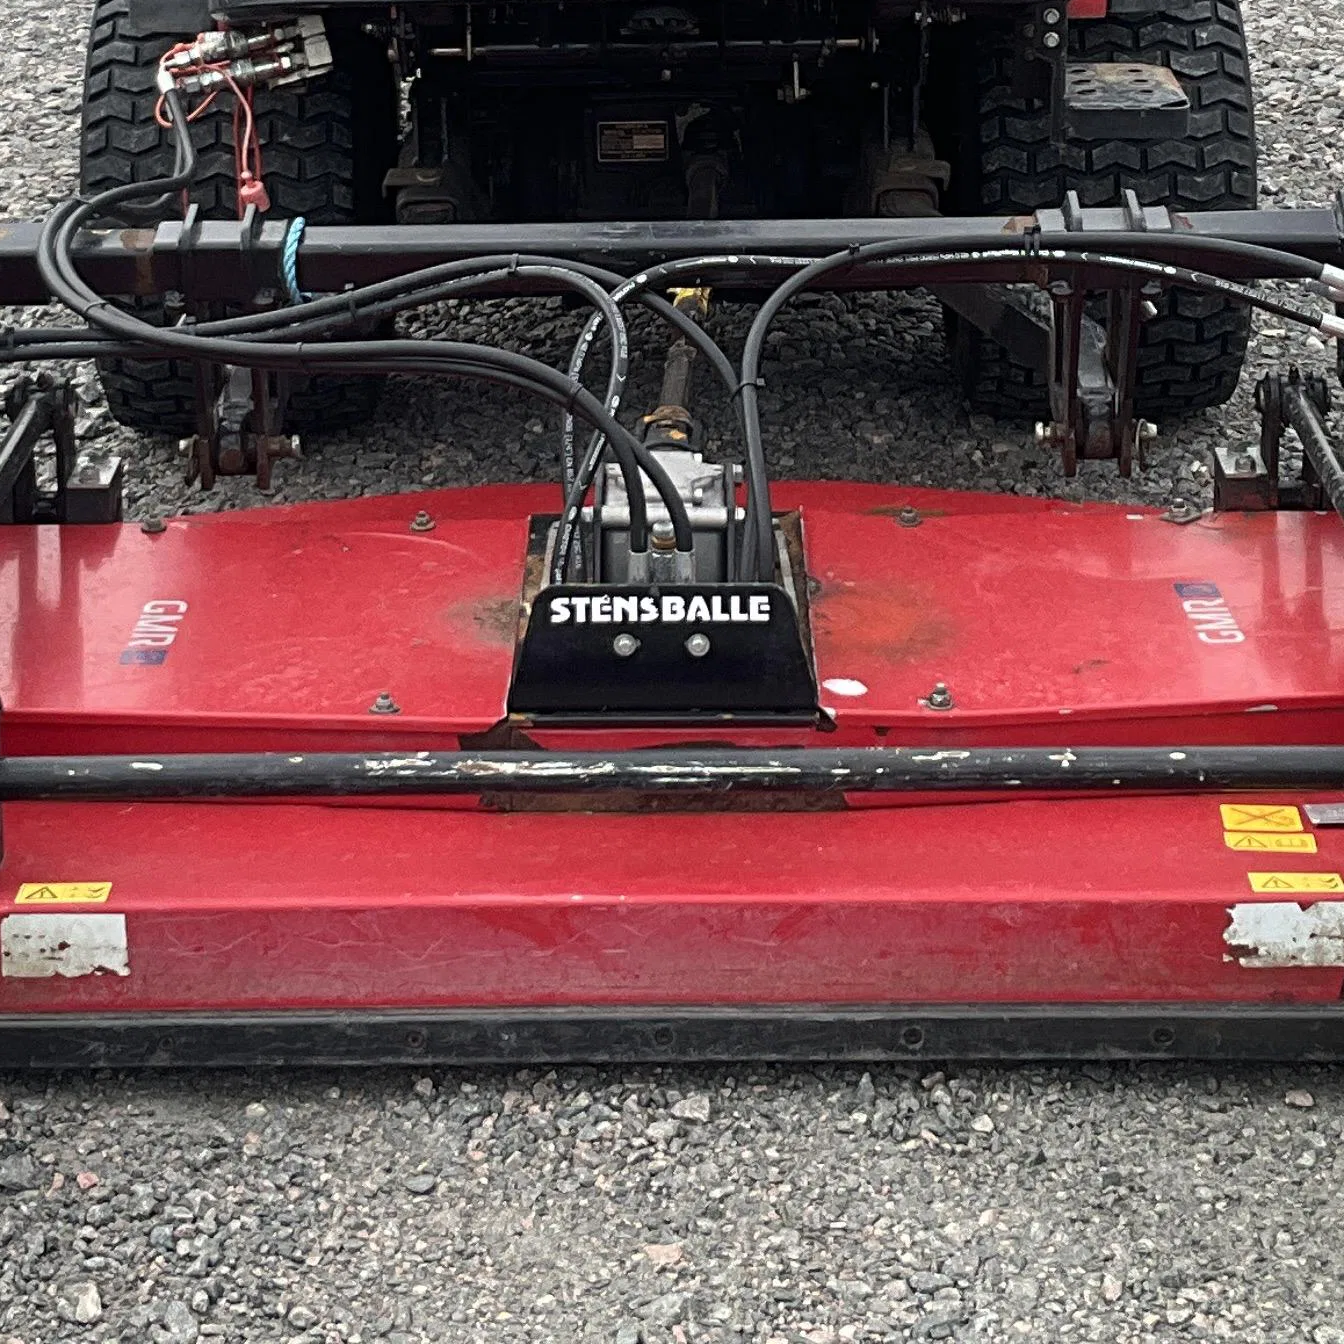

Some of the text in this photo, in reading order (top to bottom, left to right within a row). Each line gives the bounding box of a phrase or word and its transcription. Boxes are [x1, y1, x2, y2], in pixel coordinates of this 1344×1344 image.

[127, 599, 188, 647] GMR
[550, 594, 771, 623] STENSBALLE
[1182, 597, 1246, 644] GMR
